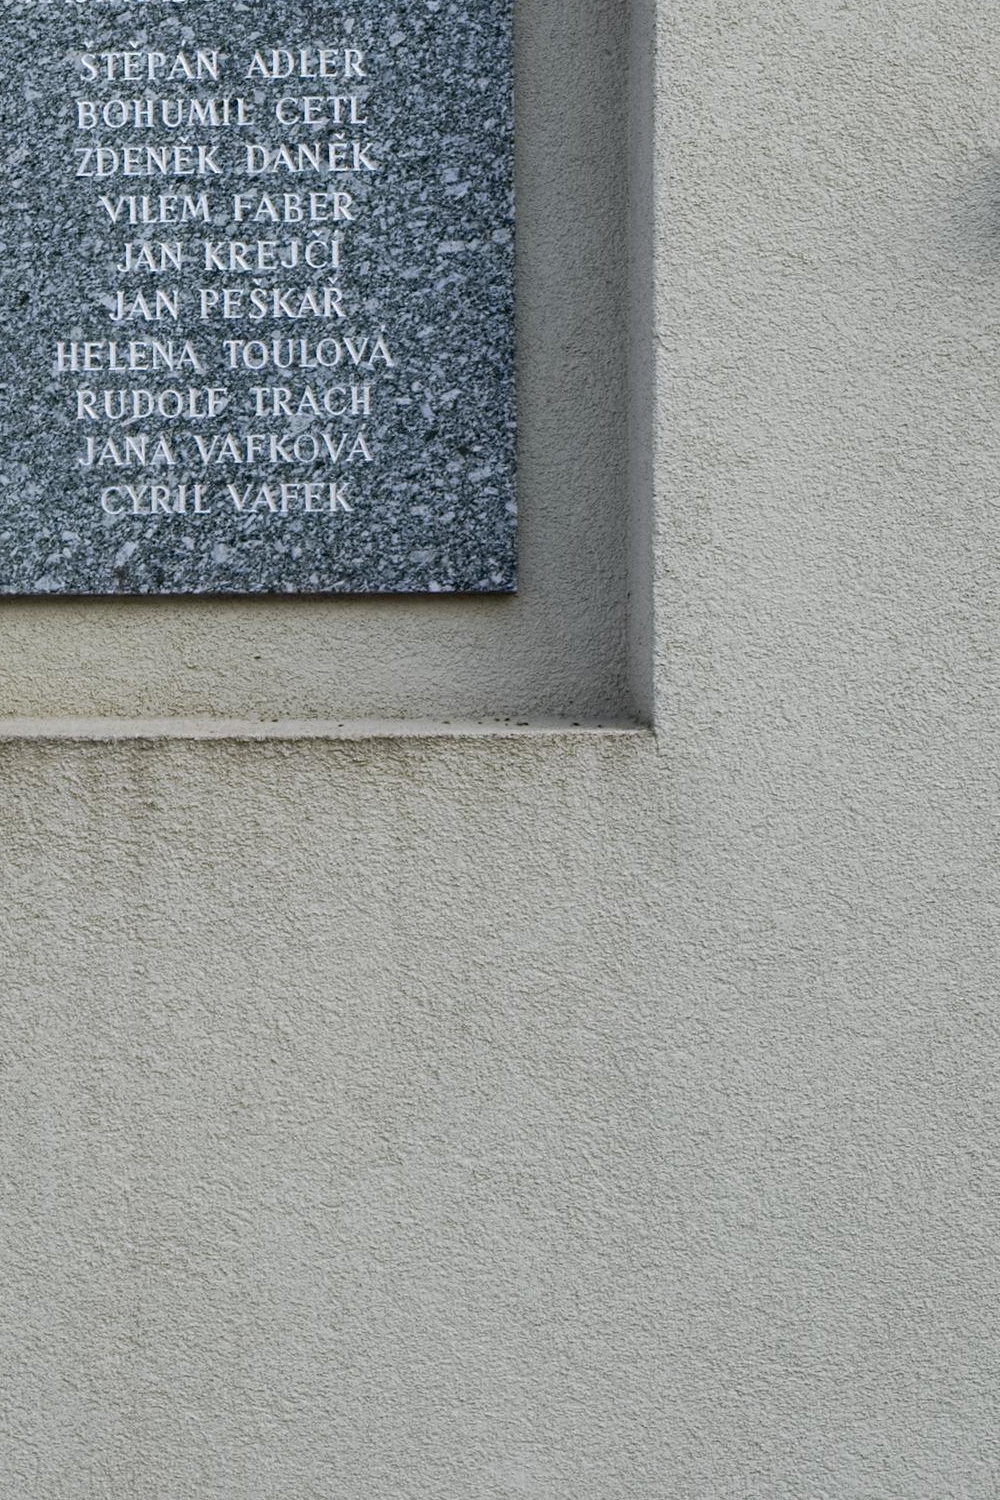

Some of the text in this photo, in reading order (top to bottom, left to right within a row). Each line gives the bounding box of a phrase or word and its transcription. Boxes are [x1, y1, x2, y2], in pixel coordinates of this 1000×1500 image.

[79, 40, 366, 80] ŠTĚPÁN ADLER
[76, 96, 368, 129] BOHUMIL CETL
[74, 132, 378, 177] ZDENĚK DANĚK
[233, 192, 356, 222] FABER
[117, 229, 340, 272] JAN KREJČÍ
[109, 277, 346, 321] JAN PEŠKAŘ
[55, 325, 395, 372] HELENA TOULOVÁ
[76, 385, 371, 419] RUDOLF TRACH
[79, 423, 374, 466] JANA VAFKOVÁ
[100, 482, 354, 515] CYRIL VAFEK
